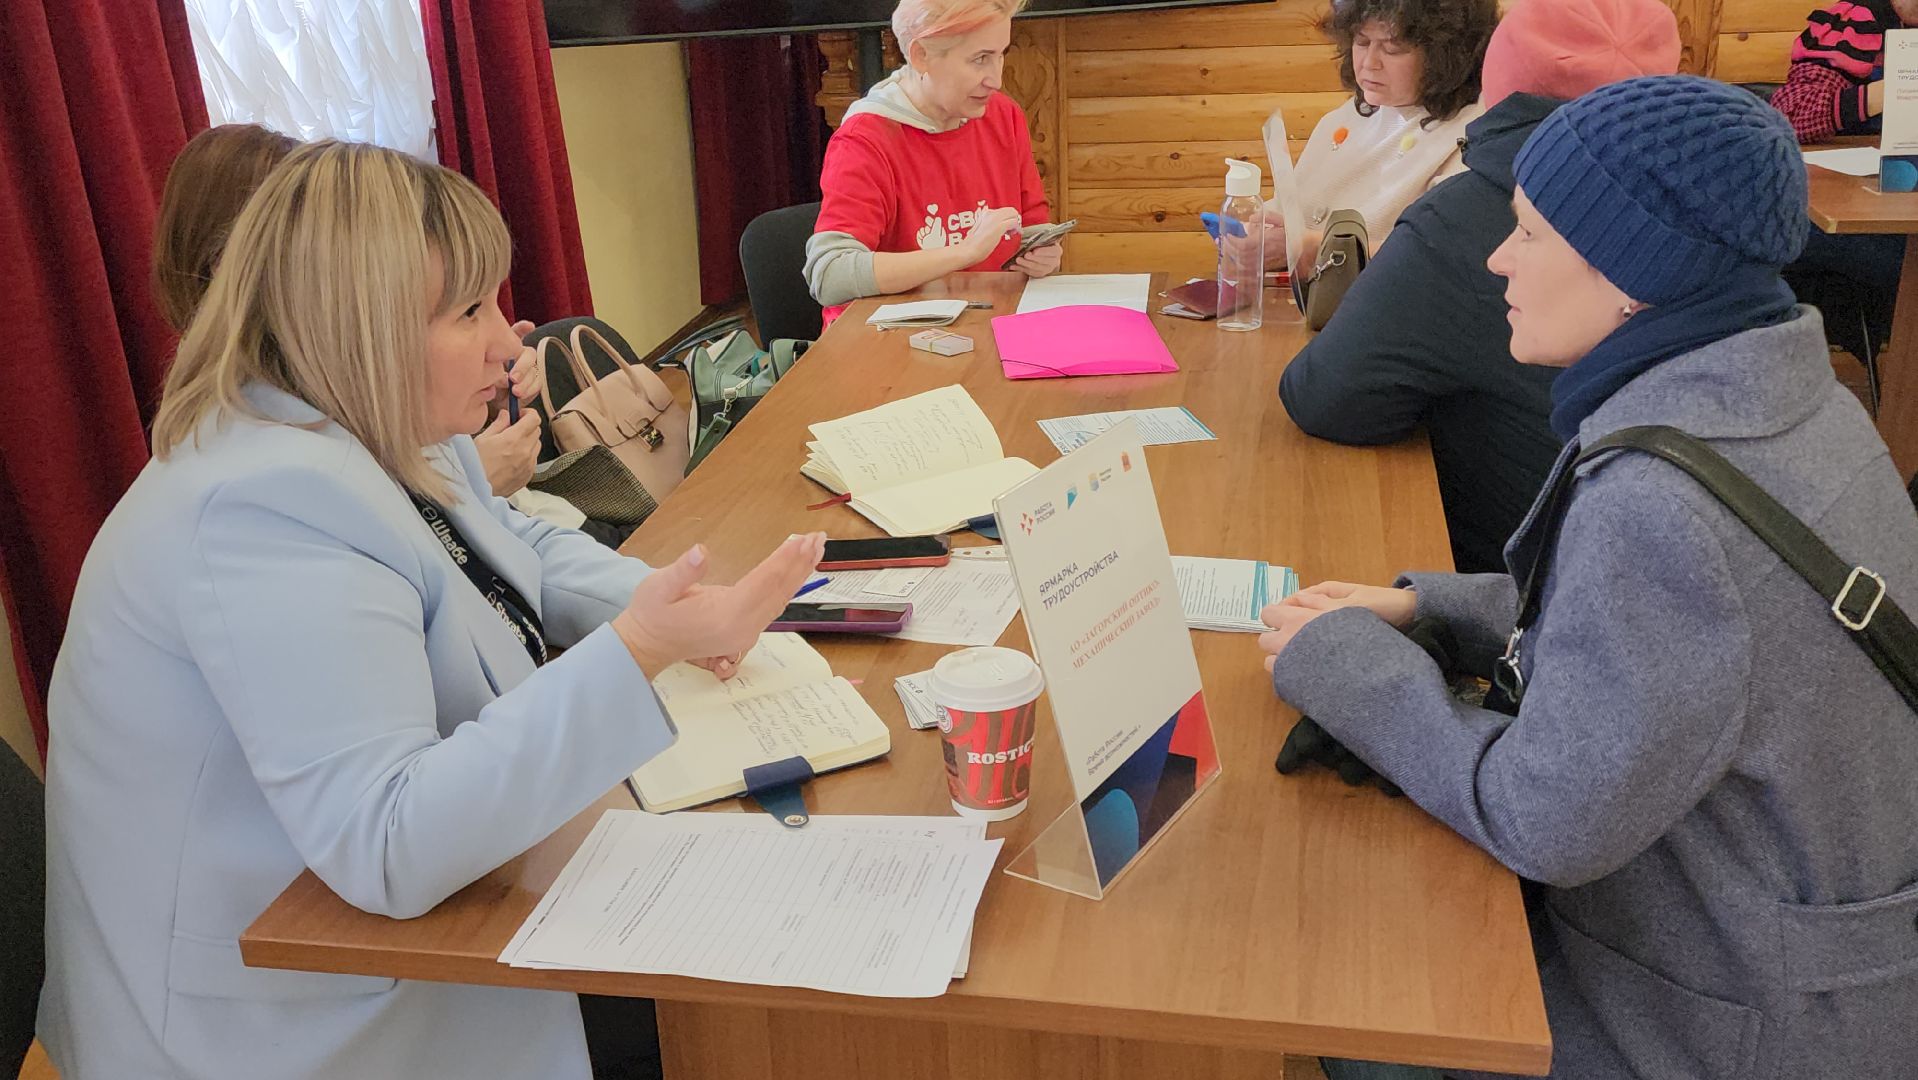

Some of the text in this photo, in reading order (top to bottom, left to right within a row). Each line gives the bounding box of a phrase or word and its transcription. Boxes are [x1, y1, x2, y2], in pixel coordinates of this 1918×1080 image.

[431, 519, 468, 565] Швабе
[1039, 562, 1079, 596] ЯРМАРКА
[1042, 550, 1119, 610] ТРУДОУСТРОЙСТВА
